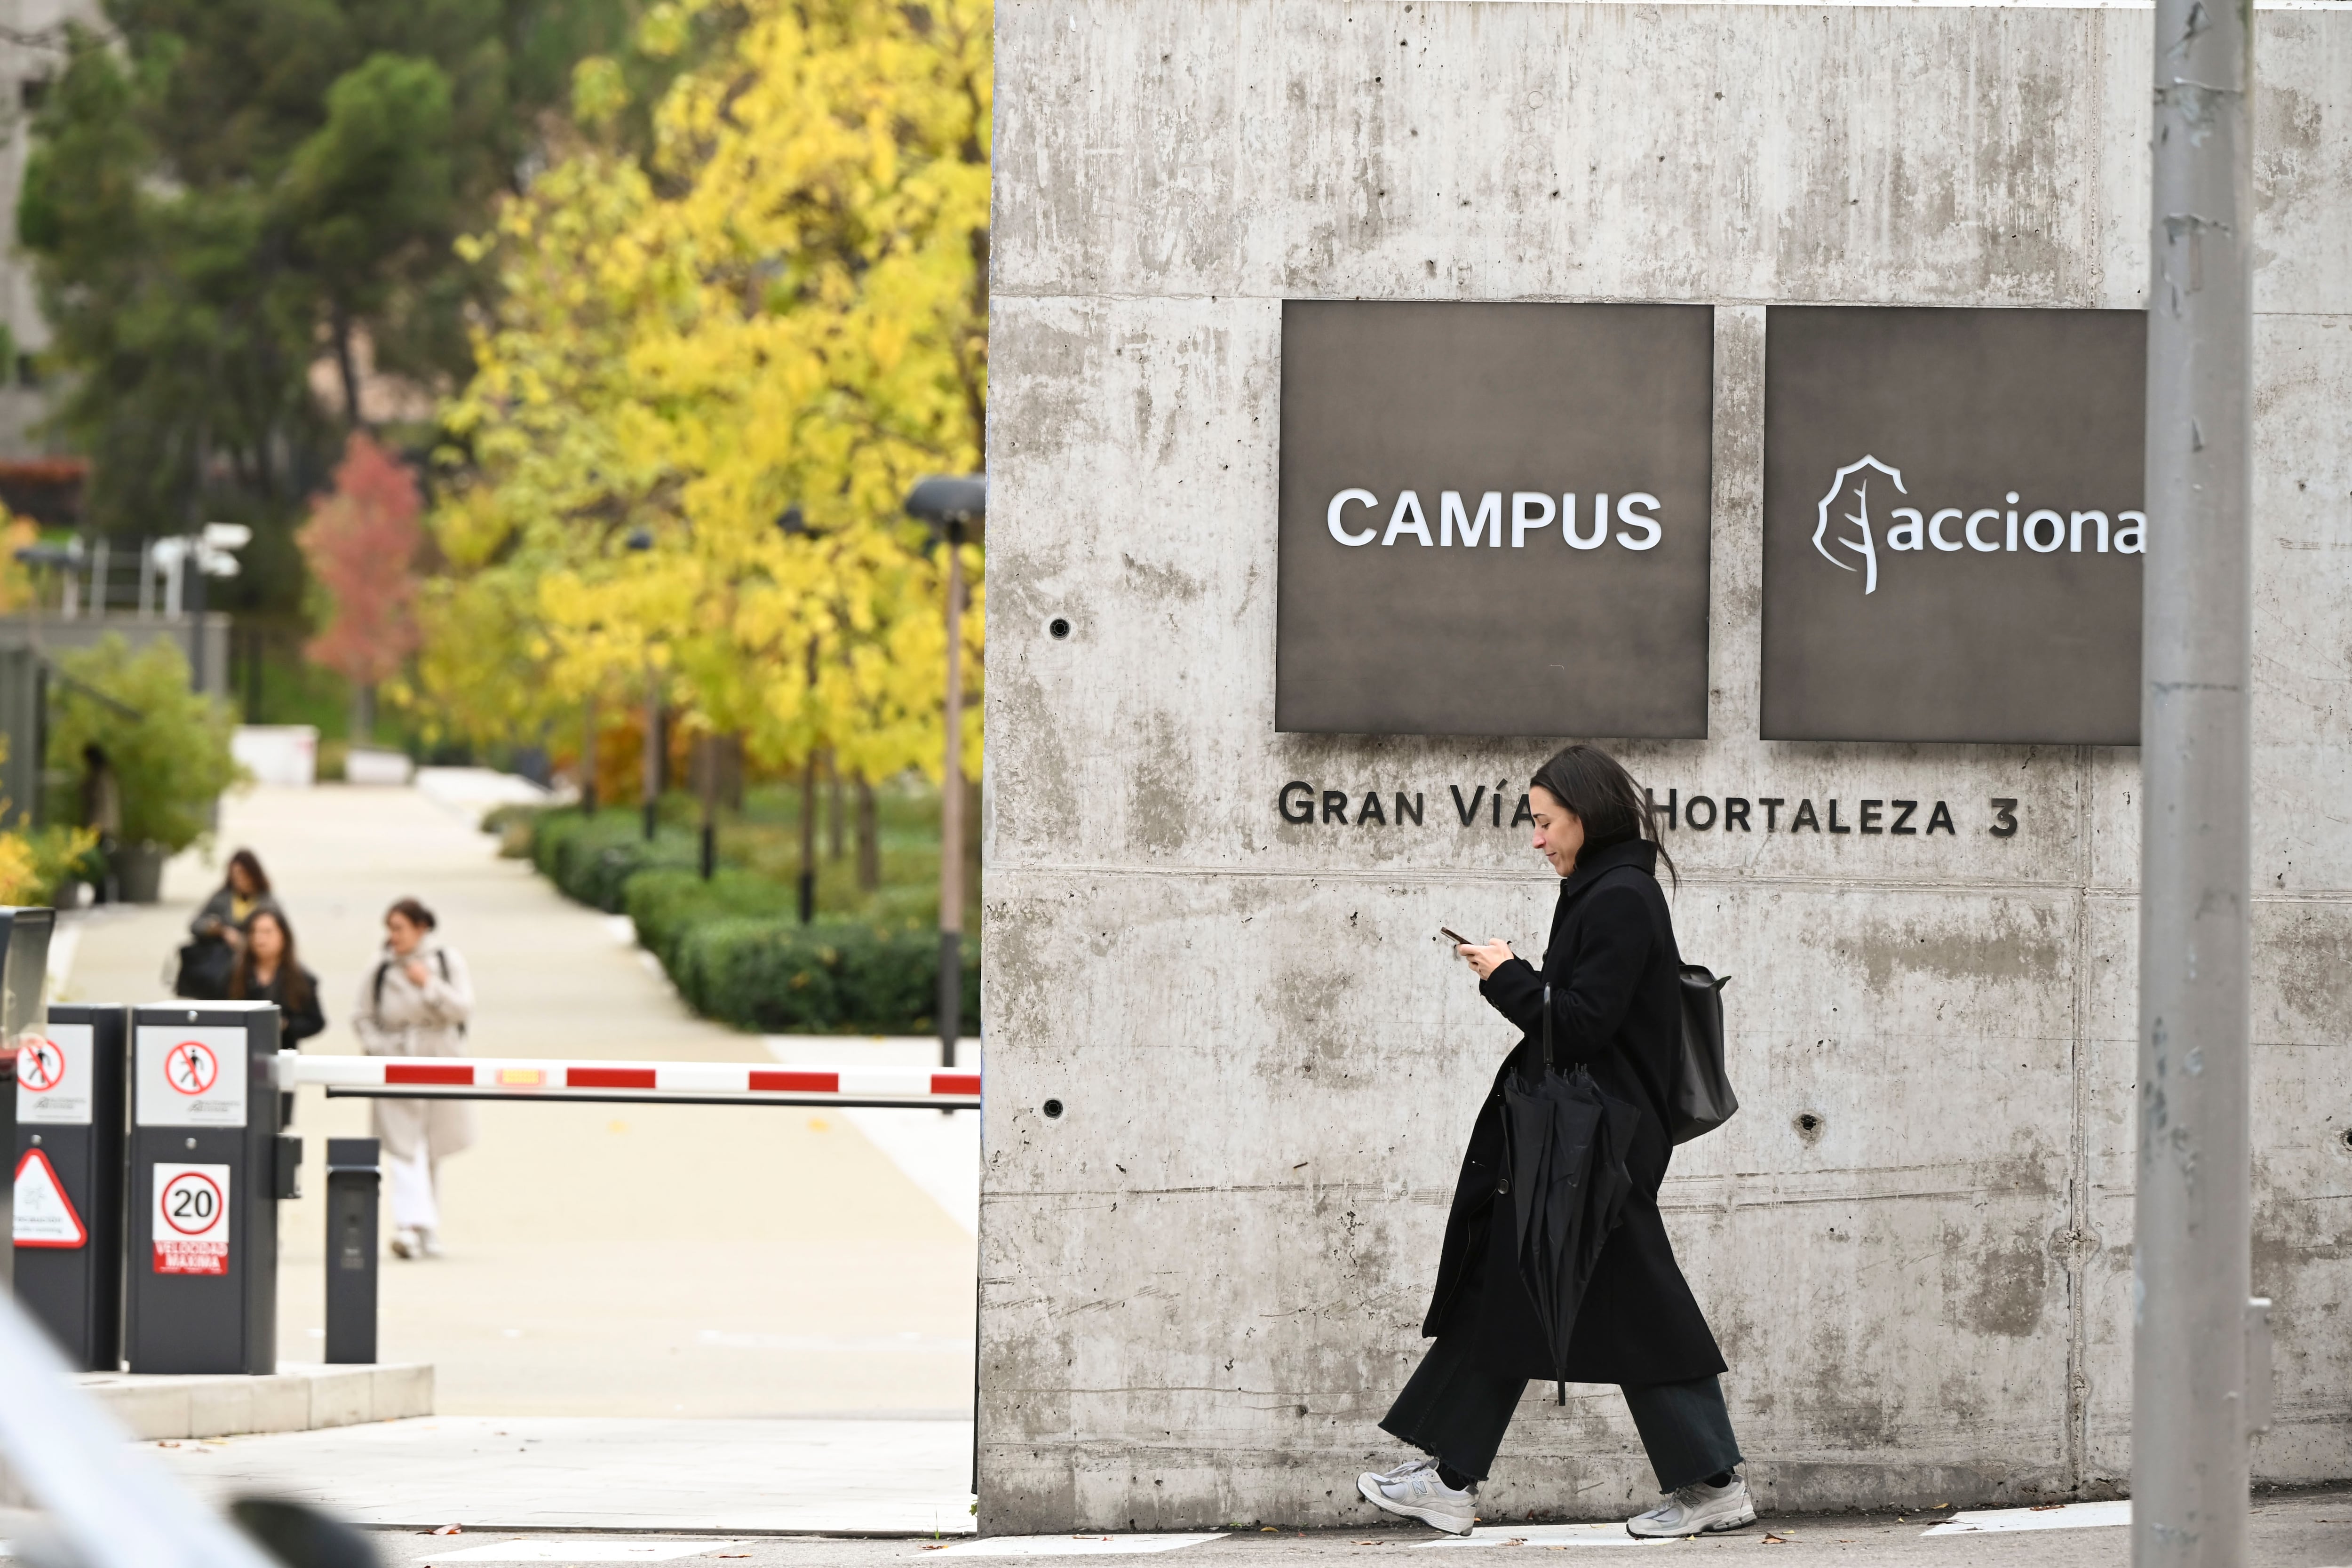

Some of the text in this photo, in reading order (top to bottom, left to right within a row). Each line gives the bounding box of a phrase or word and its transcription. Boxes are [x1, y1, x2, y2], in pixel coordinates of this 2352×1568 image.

[1327, 488, 1662, 551] CAMPUS
[1886, 491, 2148, 554] acciona
[1279, 781, 1423, 826] GRAN
[1645, 788, 1955, 836] HORTALEZA
[1988, 798, 2018, 838] 3
[174, 1189, 212, 1218] 20
[1411, 1480, 1428, 1495] N
